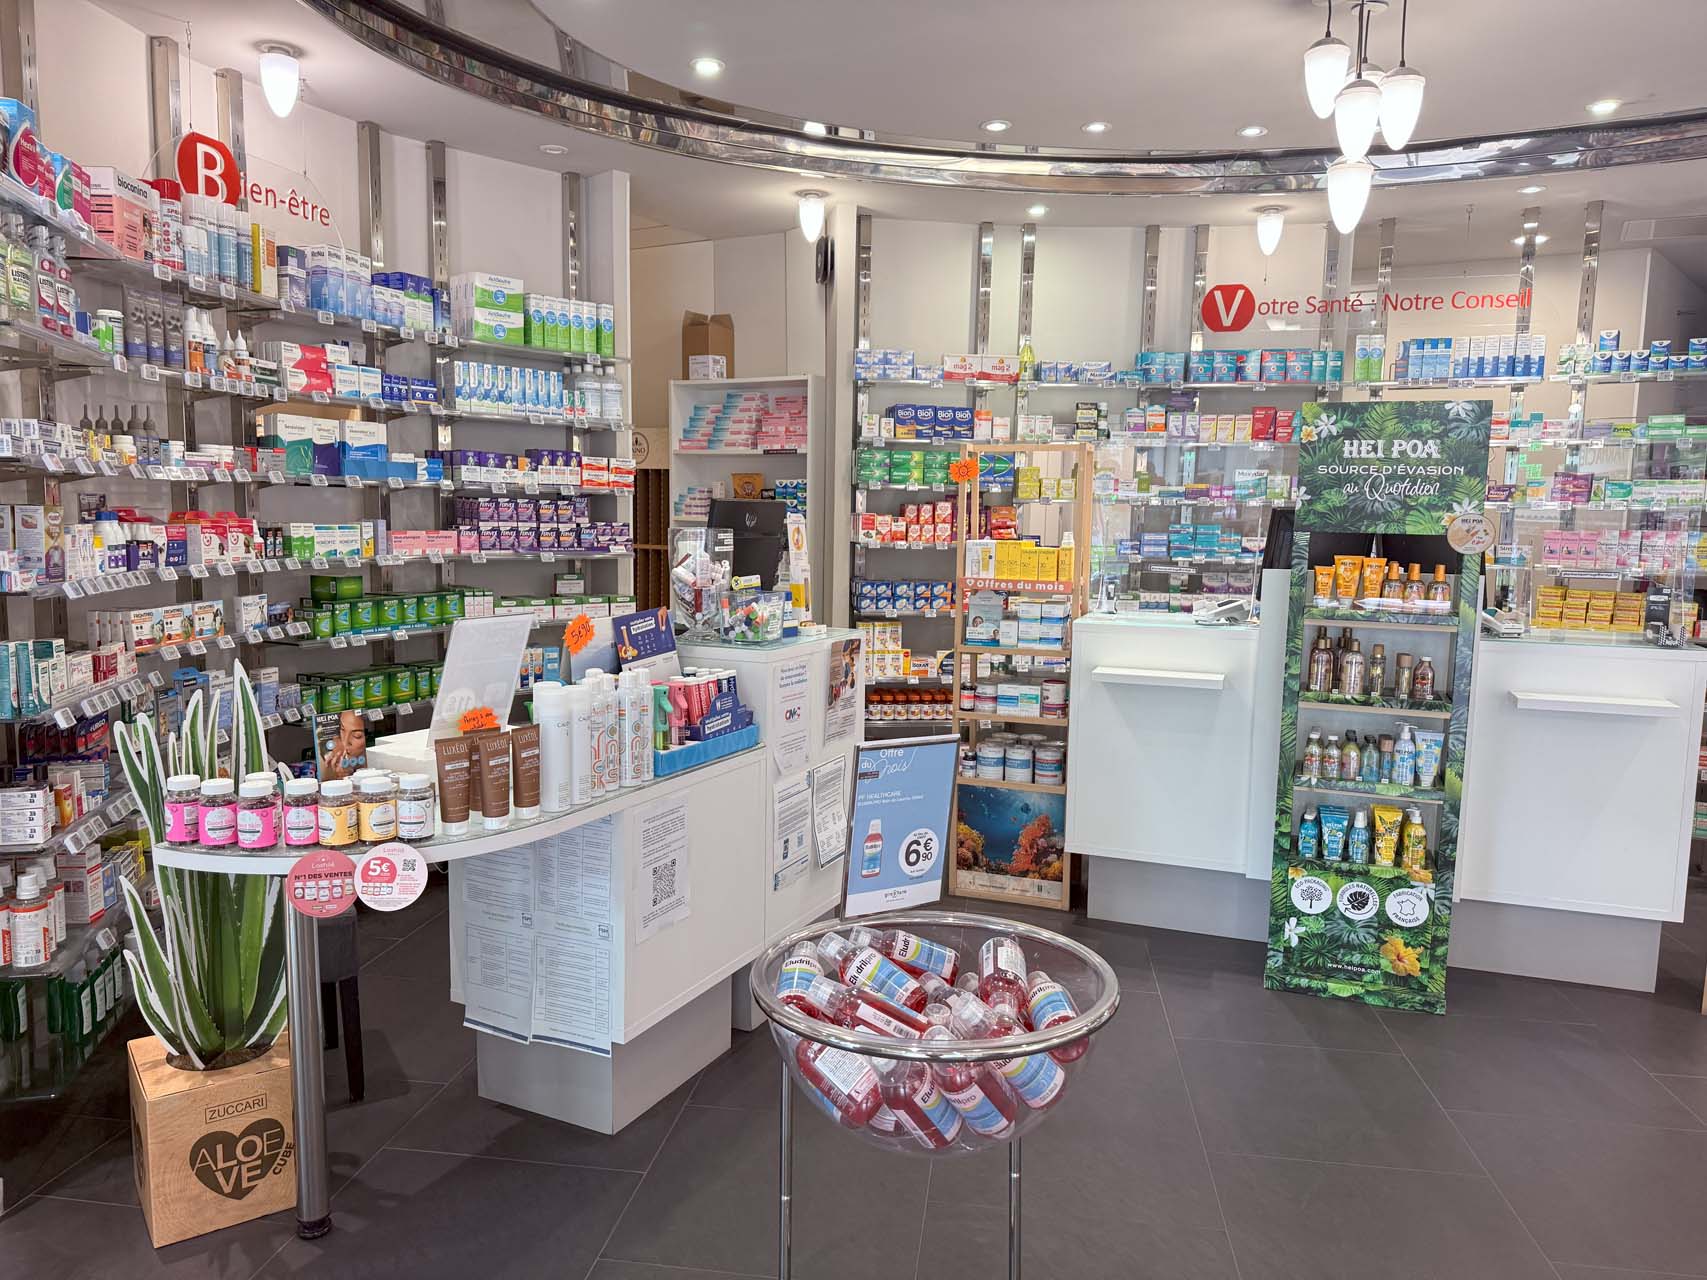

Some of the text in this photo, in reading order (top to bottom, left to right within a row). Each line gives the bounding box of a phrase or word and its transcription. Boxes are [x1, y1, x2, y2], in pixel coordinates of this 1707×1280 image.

[1305, 293, 1363, 315] Santé
[1384, 292, 1444, 312] Notre
[1451, 288, 1531, 310] Conseil
[1343, 439, 1441, 459] HEI POA
[1318, 464, 1464, 476] SOURCE D'ÉVASION
[1343, 483, 1359, 494] au
[977, 579, 1064, 591] offres du mois
[862, 761, 872, 769] du
[307, 872, 322, 880] DES
[324, 871, 353, 879] VENTES
[1327, 962, 1382, 975] www.heipoa.com
[208, 1097, 264, 1121] ZUCCARI
[272, 1141, 295, 1176] CUBE
